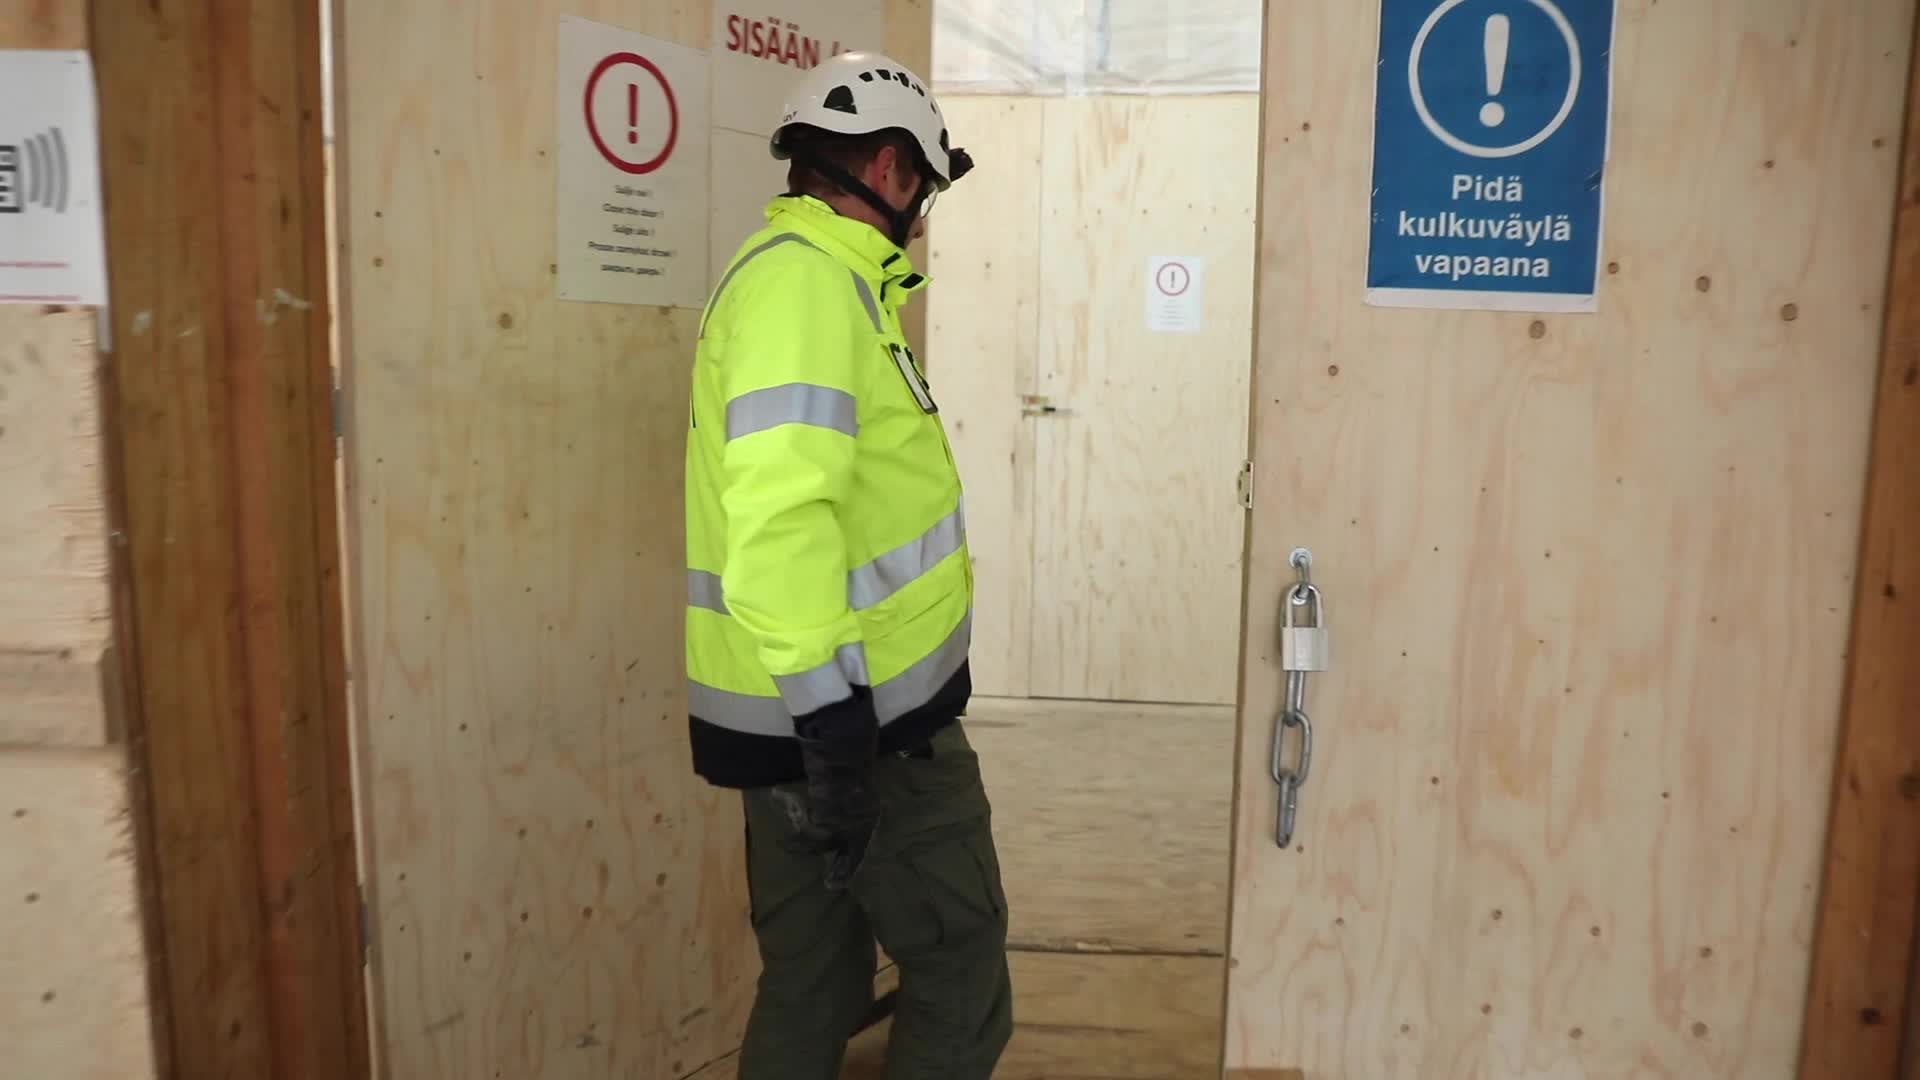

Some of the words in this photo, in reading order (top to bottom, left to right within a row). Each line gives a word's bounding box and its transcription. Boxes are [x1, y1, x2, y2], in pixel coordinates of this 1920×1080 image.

[726, 14, 820, 70] SISÄÄN
[1452, 174, 1523, 203] Pidä
[1398, 210, 1572, 246] kulkuväylä
[1414, 253, 1551, 281] vapaana
